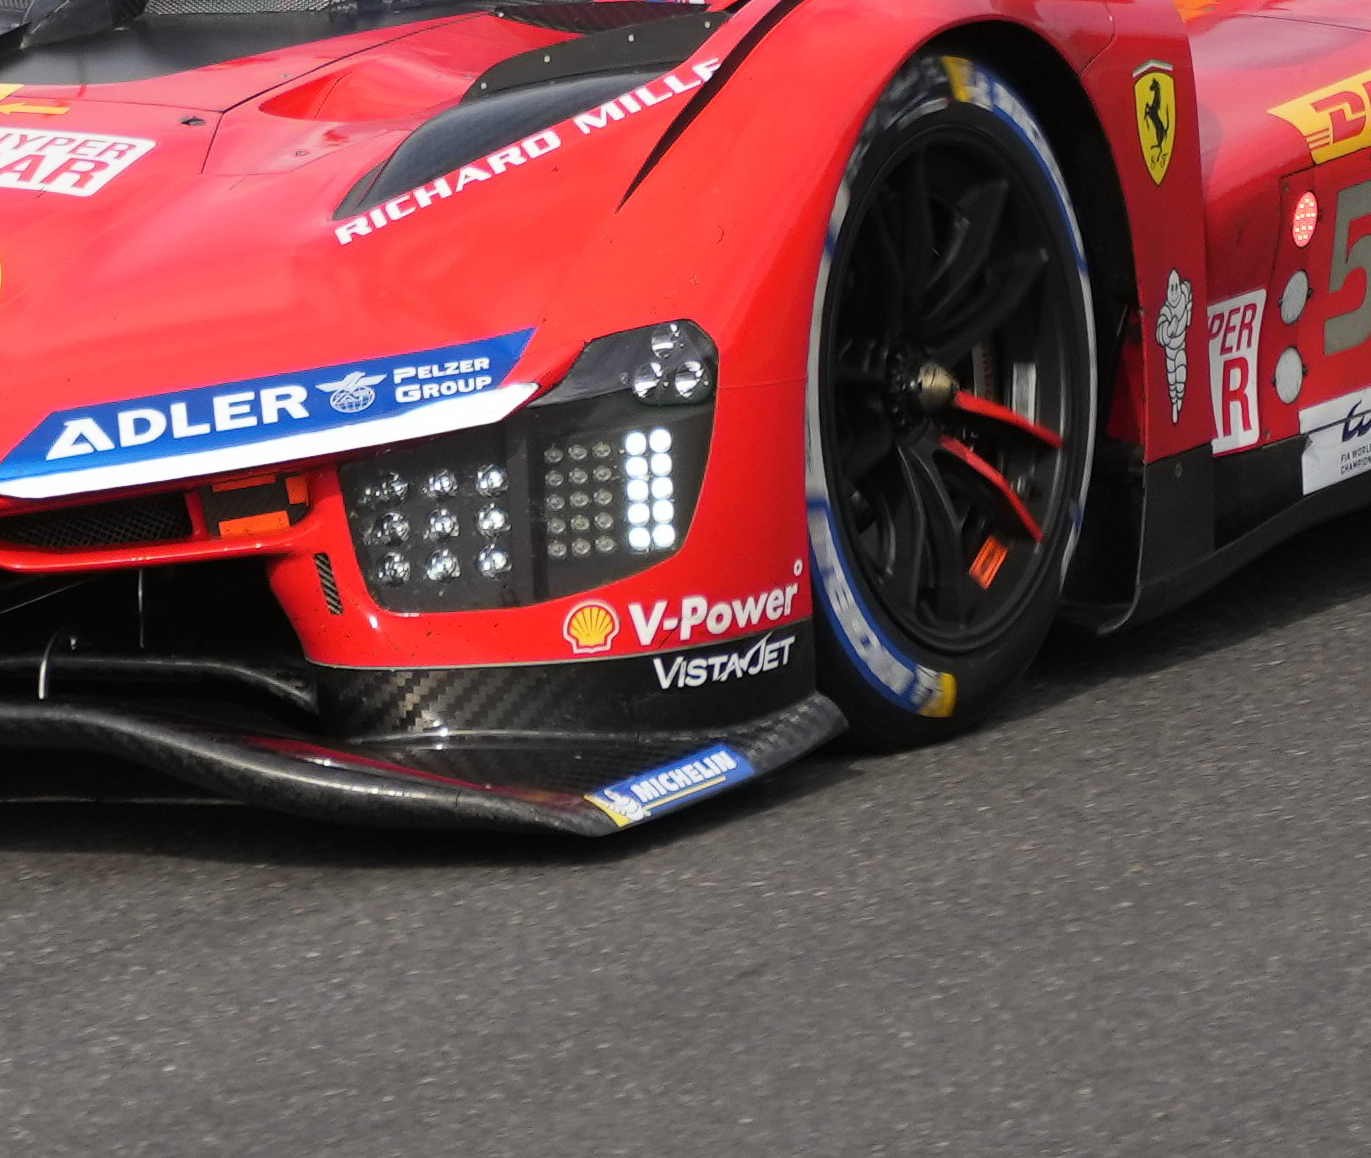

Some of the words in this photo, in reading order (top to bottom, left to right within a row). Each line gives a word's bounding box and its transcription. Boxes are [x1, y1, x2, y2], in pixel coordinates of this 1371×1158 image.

[333, 129, 562, 246] RICHARD
[393, 356, 491, 385] PELZER
[394, 374, 493, 404] GROUP
[45, 384, 311, 461] ADLER
[628, 583, 798, 646] V-Power
[653, 631, 796, 690] VISTAJET
[630, 750, 737, 803] MICHELIN
